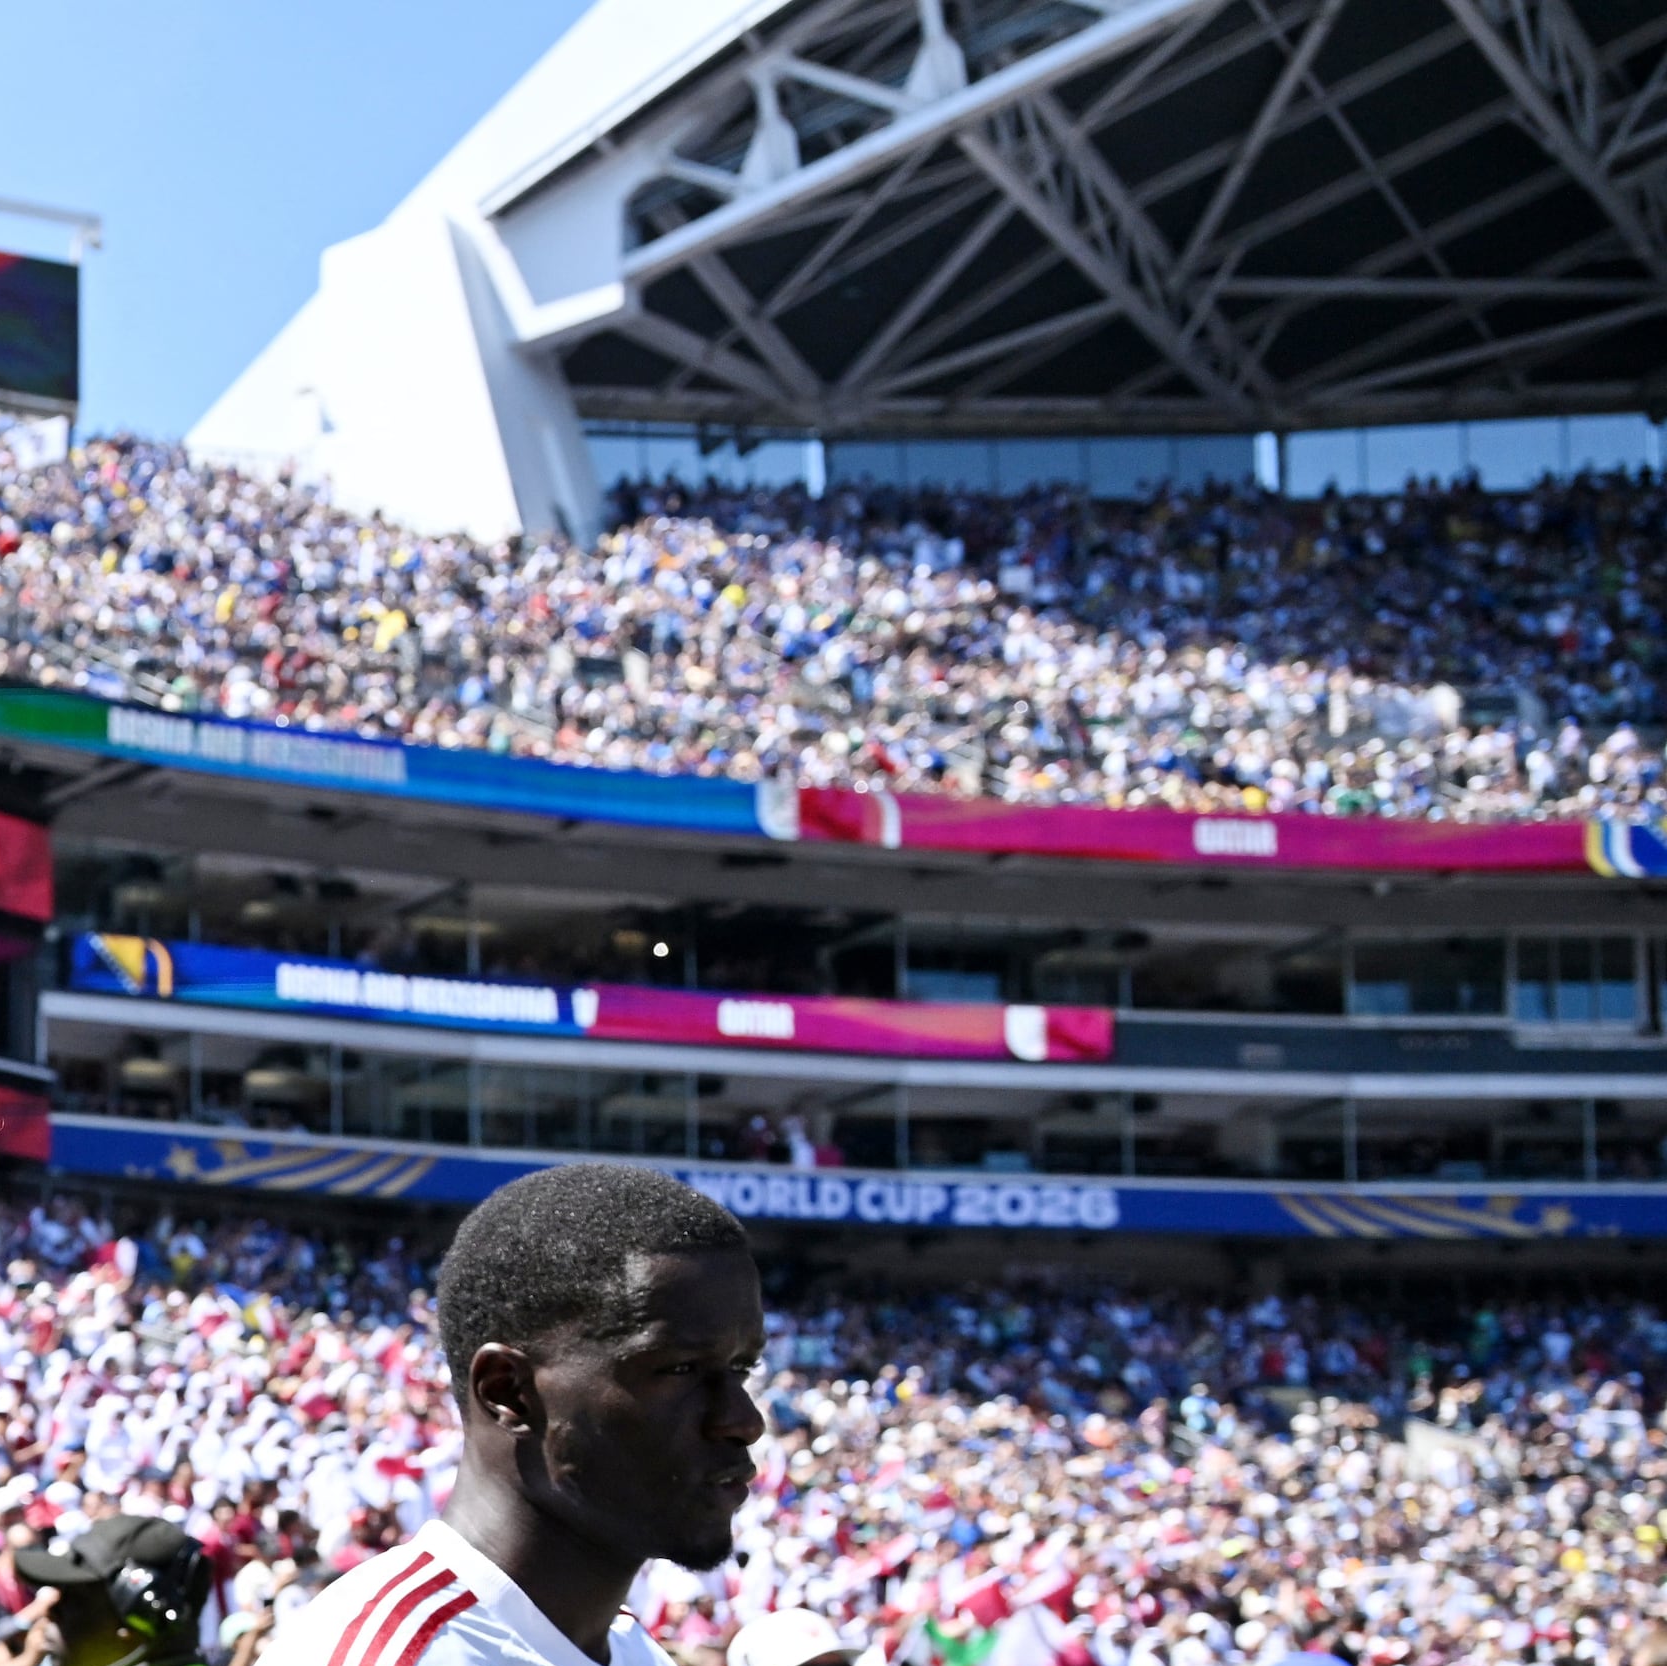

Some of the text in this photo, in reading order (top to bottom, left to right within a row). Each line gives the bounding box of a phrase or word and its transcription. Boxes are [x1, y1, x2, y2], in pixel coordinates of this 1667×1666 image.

[691, 1172, 1121, 1230] WORLD CUP 2026
